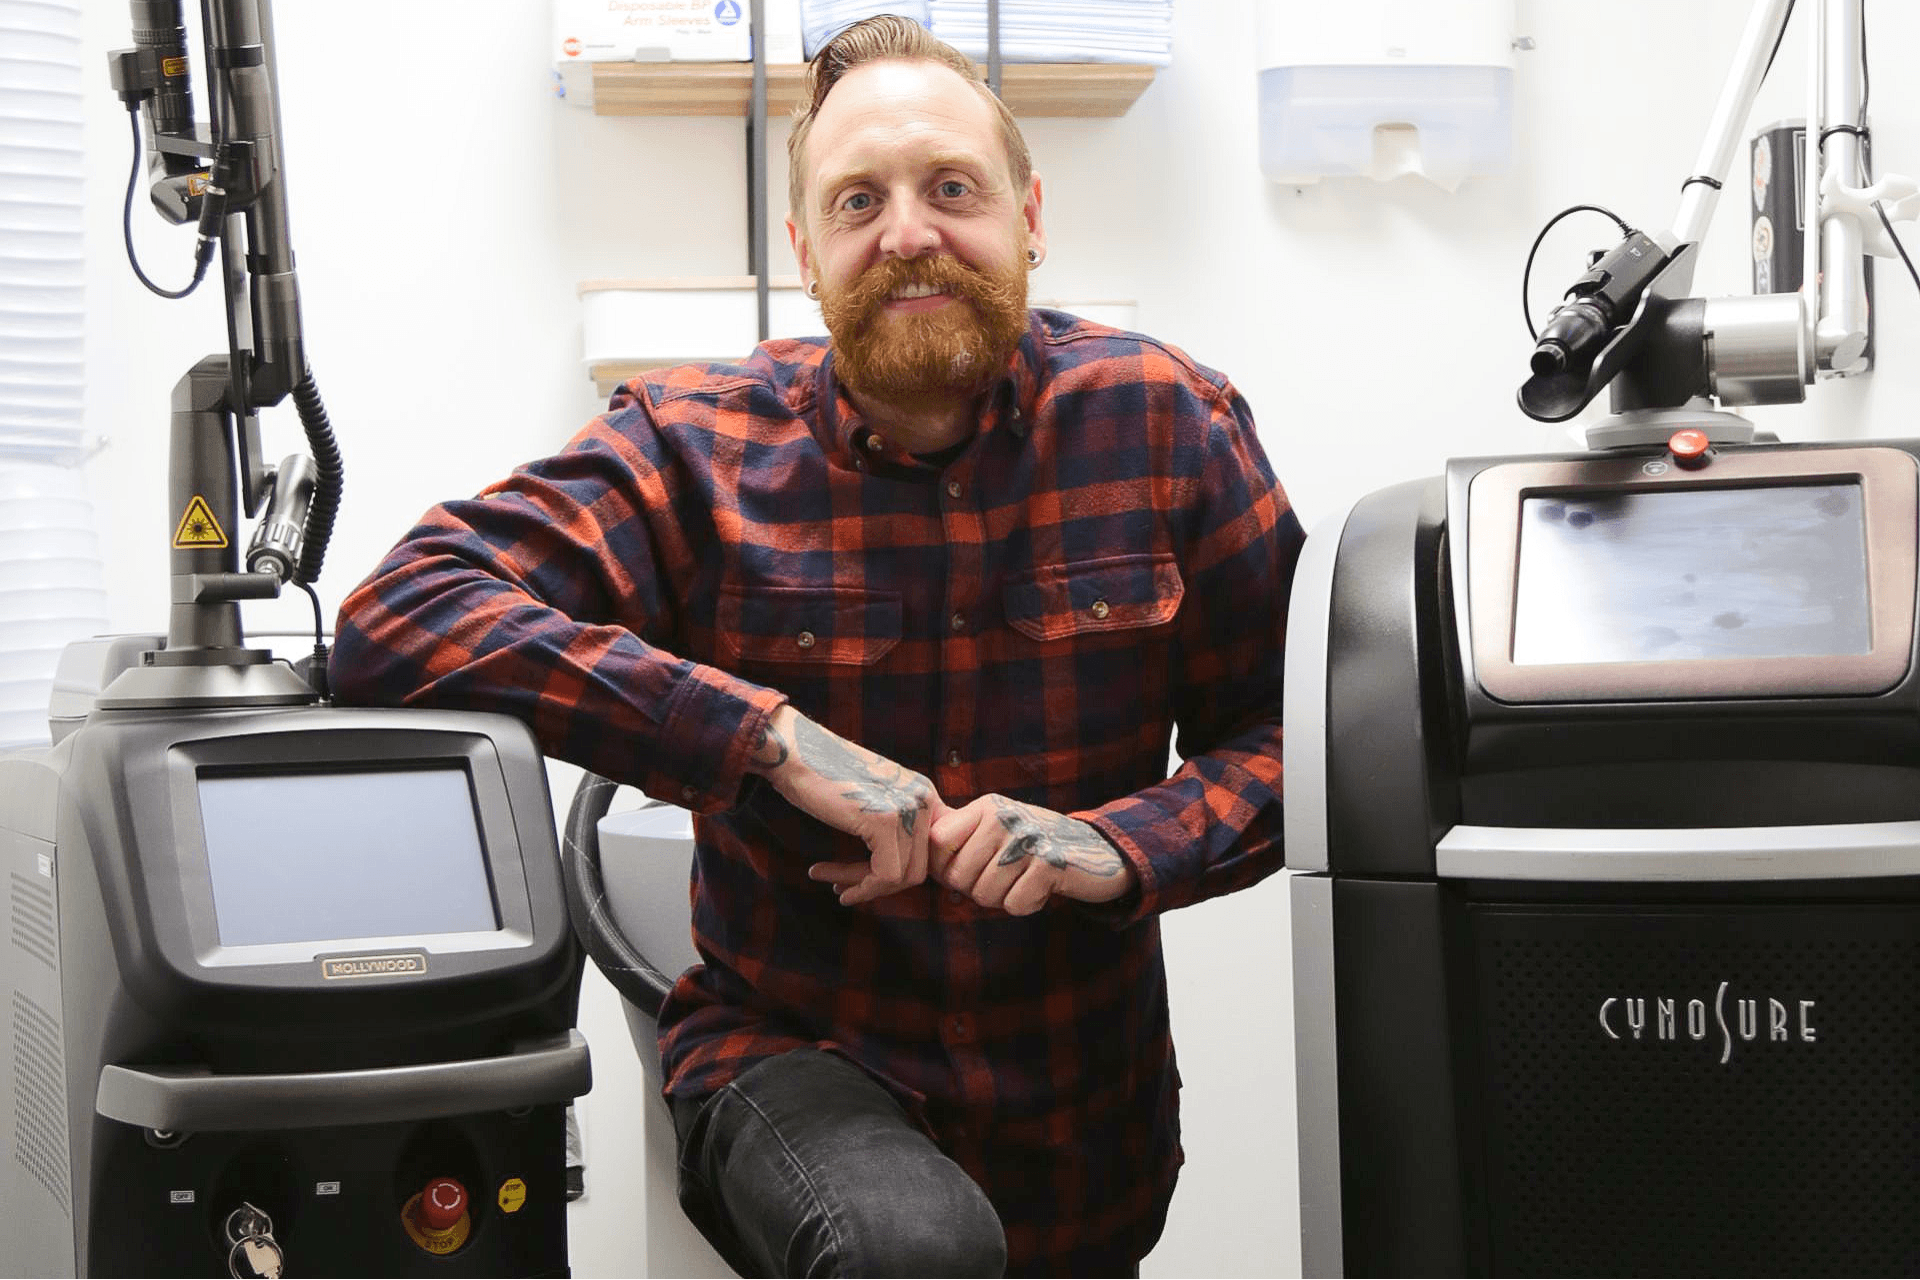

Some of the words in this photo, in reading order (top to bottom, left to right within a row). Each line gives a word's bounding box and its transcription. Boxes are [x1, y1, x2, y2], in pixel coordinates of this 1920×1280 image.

[623, 15, 653, 26] Arm
[658, 14, 711, 26] Sleeves
[331, 959, 417, 974] HOLLYWOOD
[1599, 981, 1816, 1063] CYNOSURE
[425, 1237, 454, 1249] STOP
